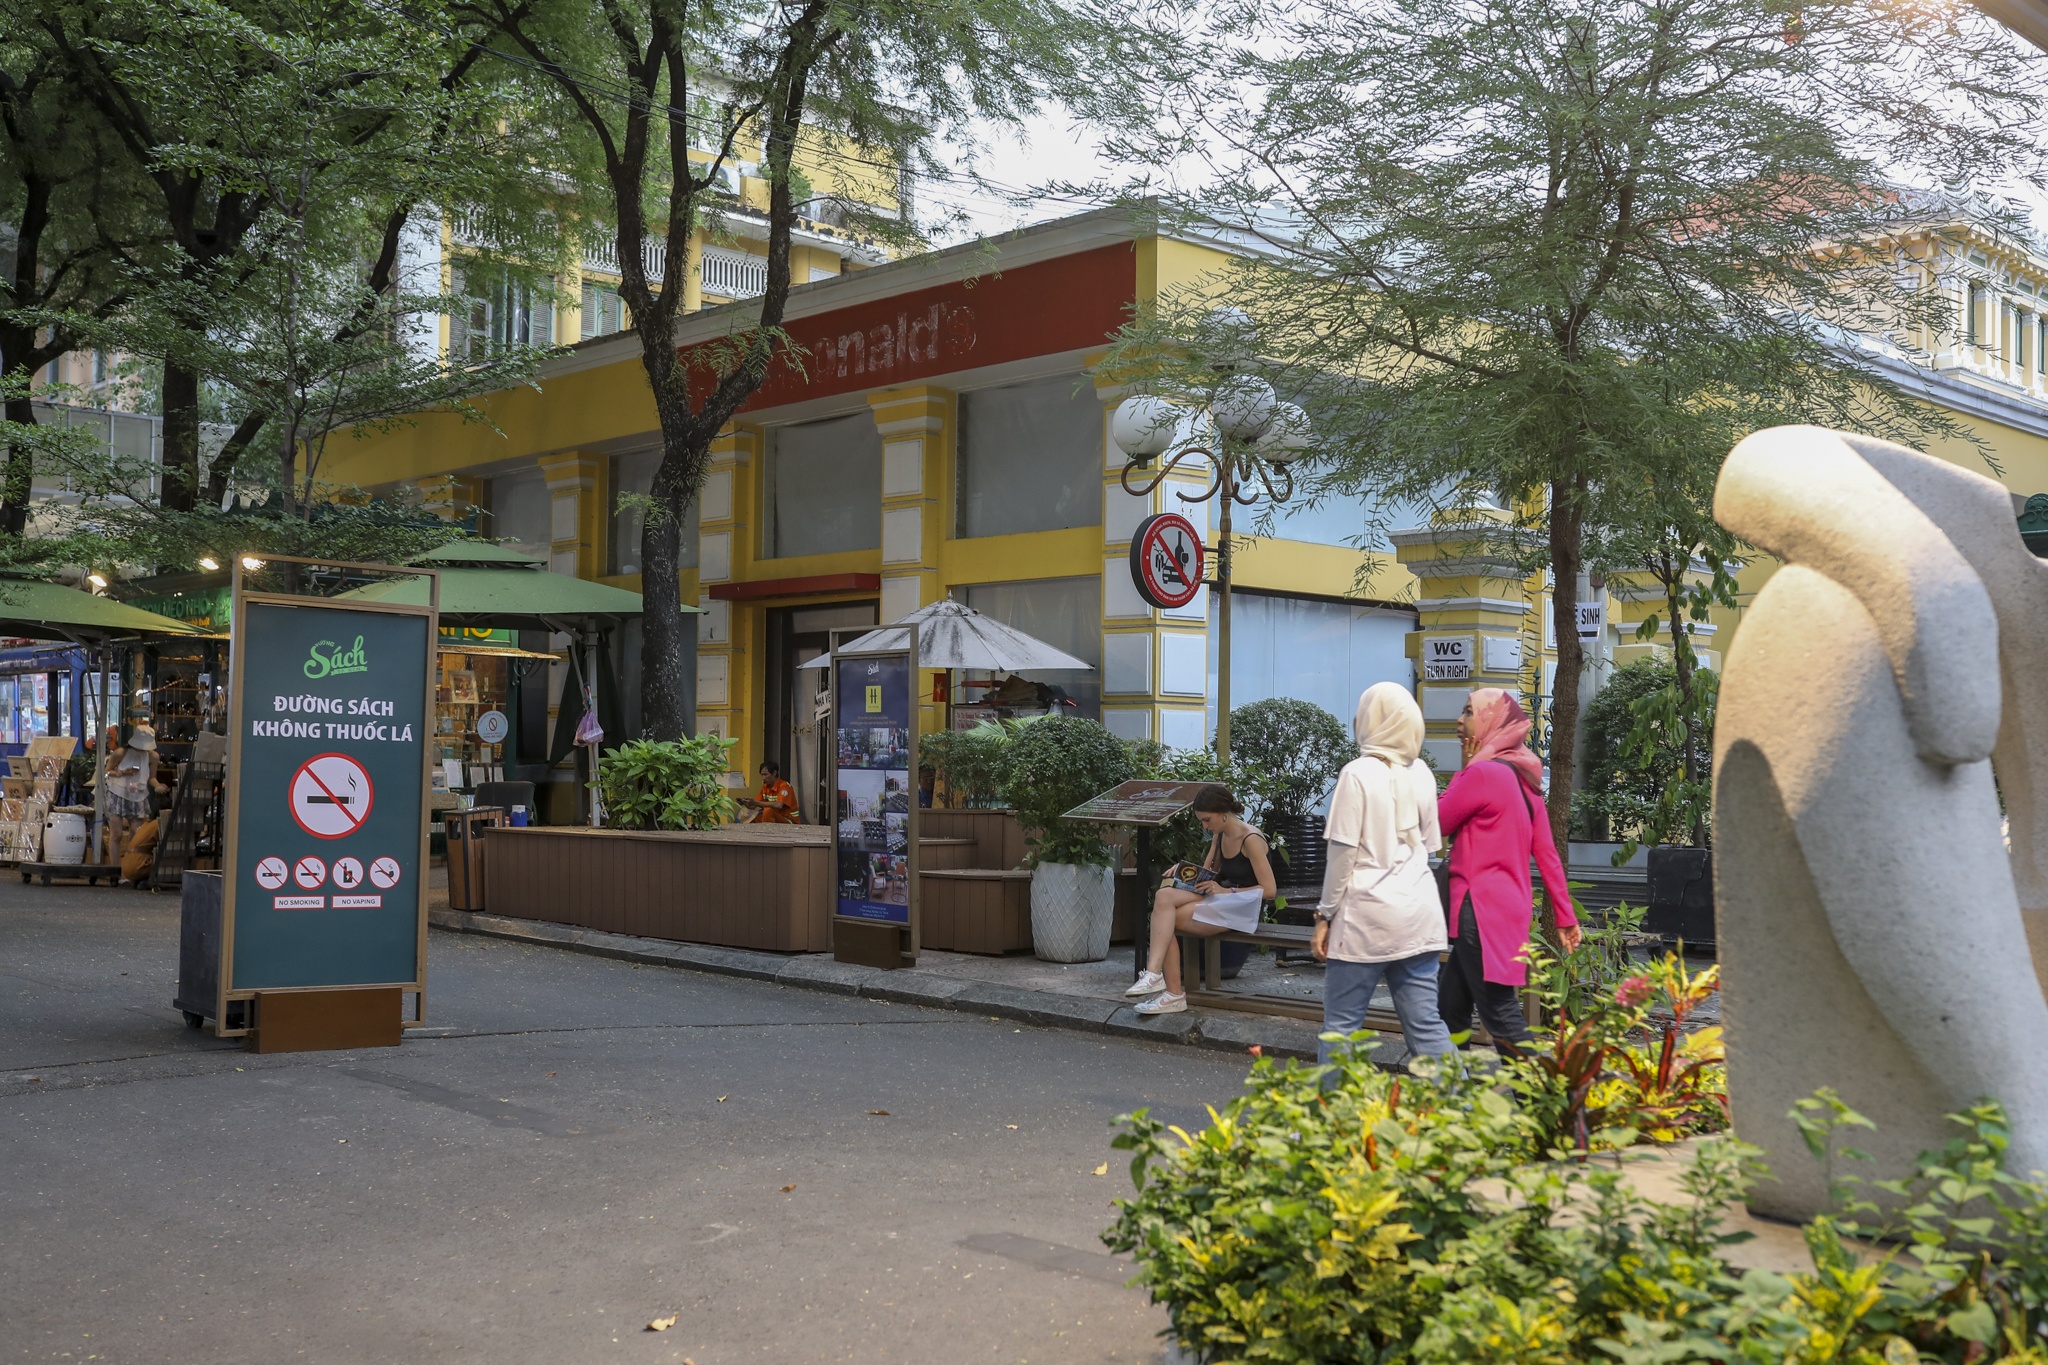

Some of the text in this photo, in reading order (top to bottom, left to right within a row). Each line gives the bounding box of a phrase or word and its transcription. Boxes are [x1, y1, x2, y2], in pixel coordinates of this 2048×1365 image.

[1581, 607, 1600, 625] SINH
[304, 635, 367, 679] Sách
[1434, 642, 1462, 655] WC
[1427, 665, 1469, 678] TURN RIGHT
[273, 694, 394, 716] ĐƯỜNG SÁCH
[252, 719, 413, 742] KHÔNG THUỐC LÁ
